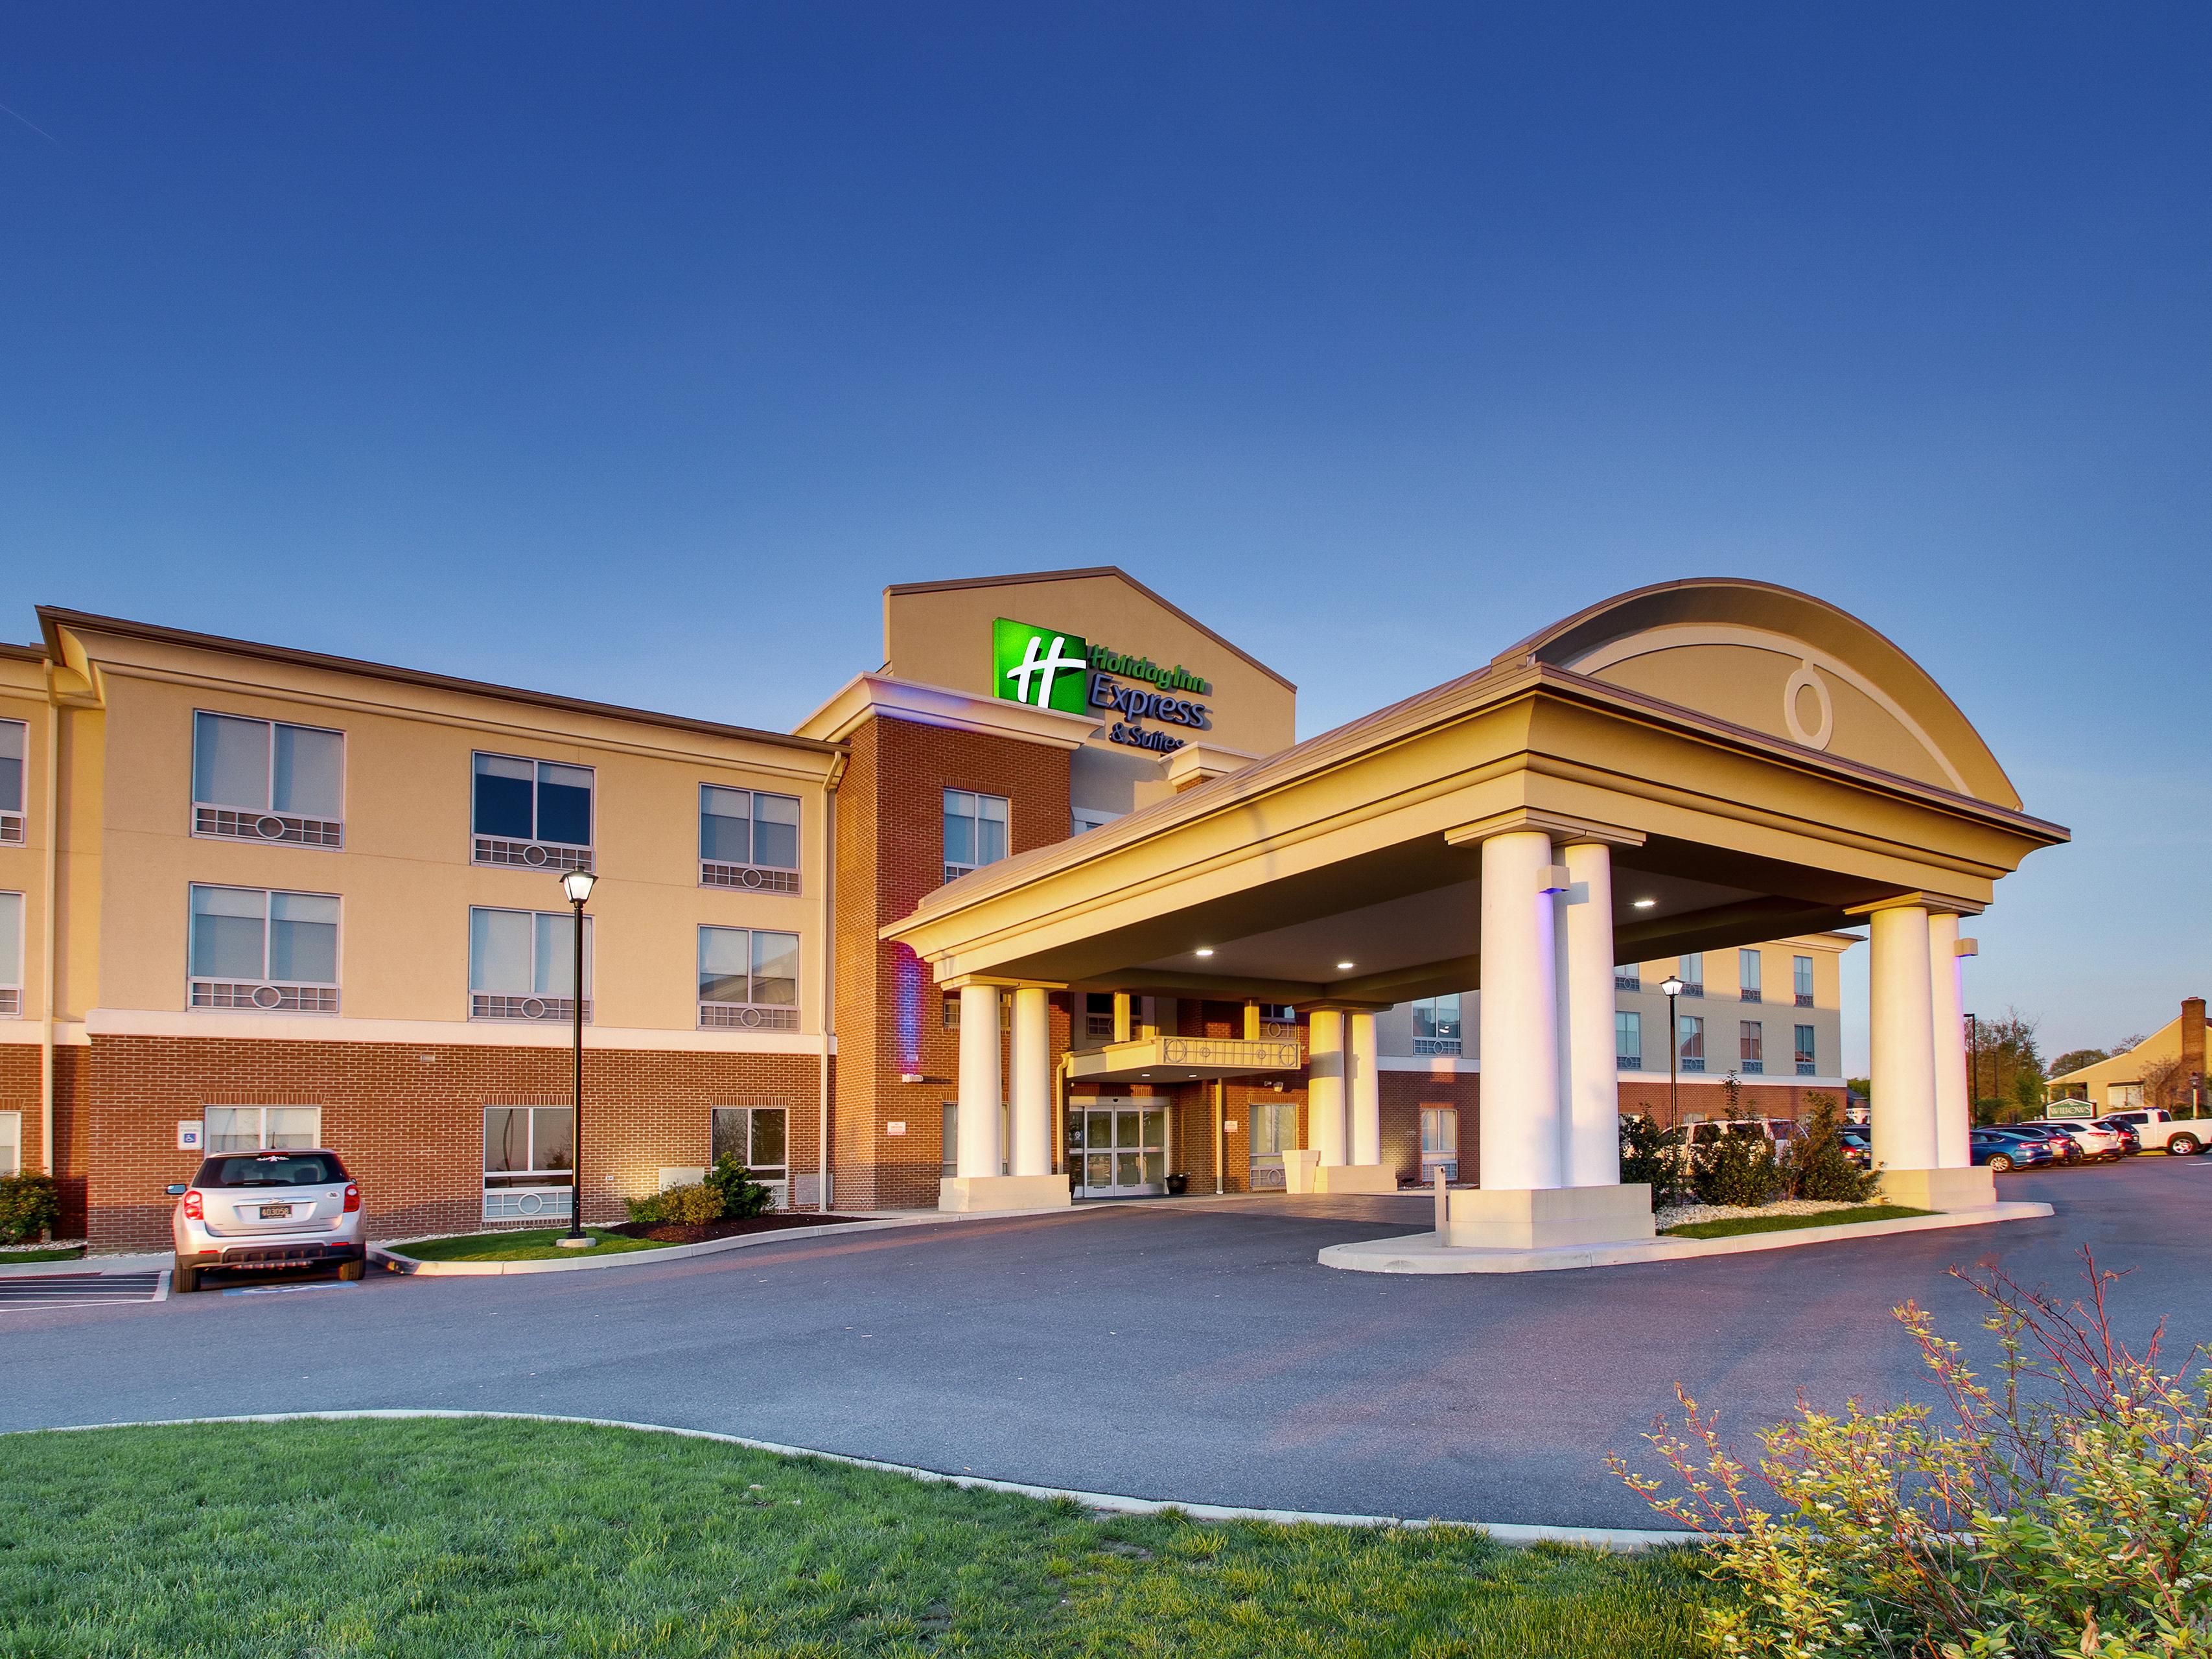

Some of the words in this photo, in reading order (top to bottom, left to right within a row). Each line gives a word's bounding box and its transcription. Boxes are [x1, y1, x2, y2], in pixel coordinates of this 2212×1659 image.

[1089, 644, 1172, 690] Holiday
[1172, 664, 1205, 693] Inn
[1089, 673, 1205, 728] Express
[1109, 722, 1125, 743] &
[2049, 1106, 2091, 1115] WILLOWS
